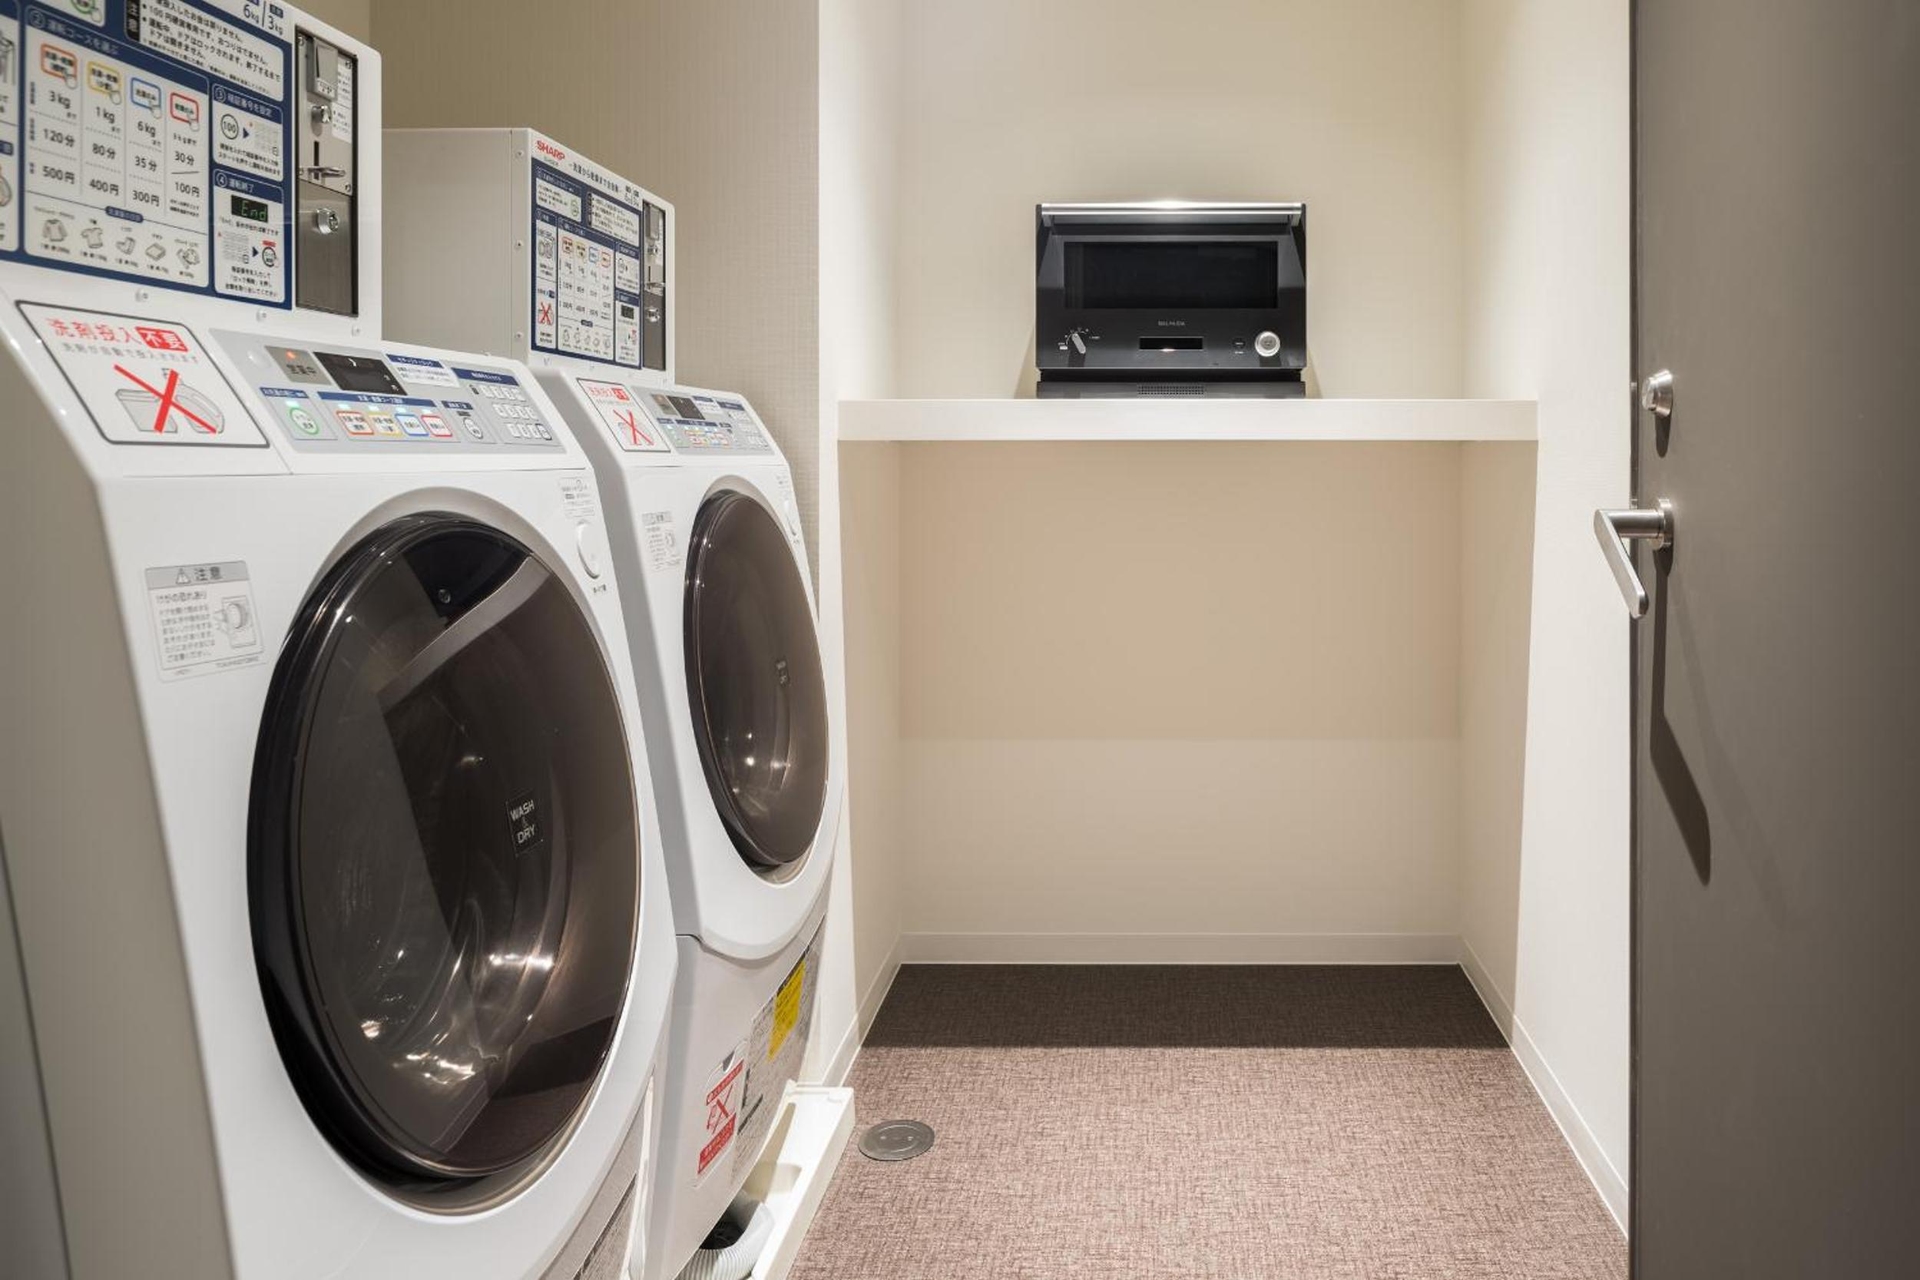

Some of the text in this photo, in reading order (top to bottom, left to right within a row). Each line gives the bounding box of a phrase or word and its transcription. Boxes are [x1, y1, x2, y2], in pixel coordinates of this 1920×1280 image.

[243, 4, 259, 24] 6kg
[268, 15, 283, 35] 3kg
[43, 129, 75, 148] 120分
[137, 121, 156, 138] 6kg
[92, 143, 116, 160] 80分
[174, 151, 195, 166] 30分
[537, 140, 565, 160] SHARP
[135, 155, 157, 172] 35分
[43, 165, 75, 185] 500円
[89, 179, 119, 197] 400円
[174, 181, 200, 198] 100円
[132, 190, 160, 207] 300円
[241, 200, 267, 222] End
[510, 800, 535, 821] WASH
[517, 824, 535, 844] DRY
